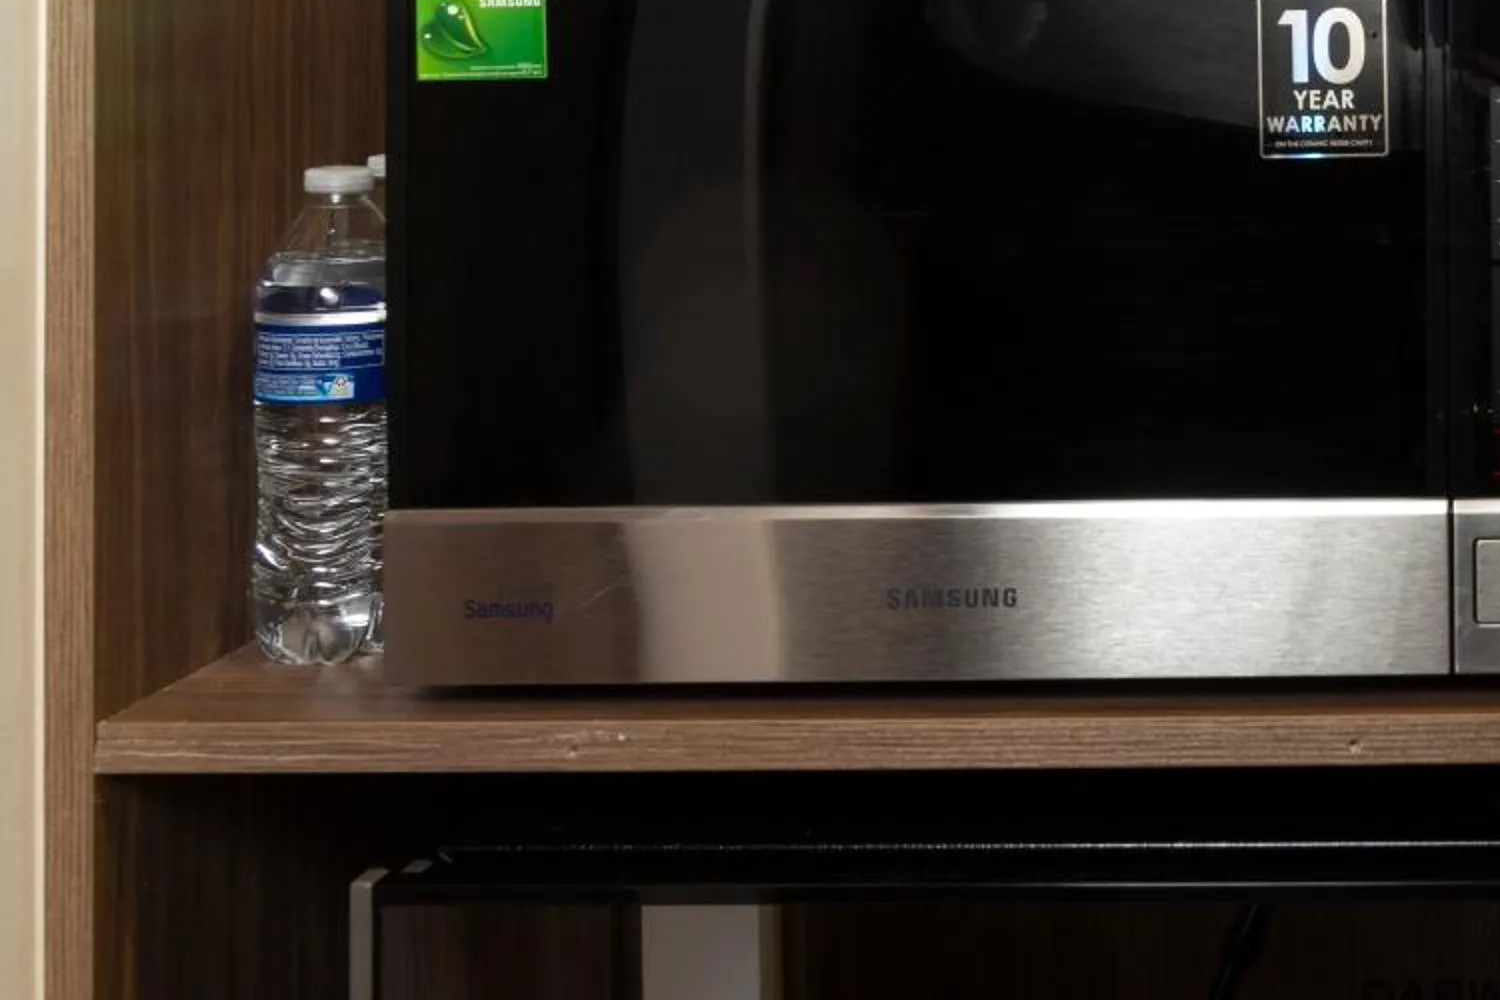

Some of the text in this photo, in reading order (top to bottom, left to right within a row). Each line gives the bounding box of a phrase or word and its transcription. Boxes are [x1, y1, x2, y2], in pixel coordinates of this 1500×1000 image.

[1277, 7, 1366, 85] 10
[1293, 89, 1355, 110] YEAR
[1266, 114, 1383, 133] WARRANTY
[886, 587, 1018, 611] SAMSUNG
[463, 599, 555, 625] Samsung
